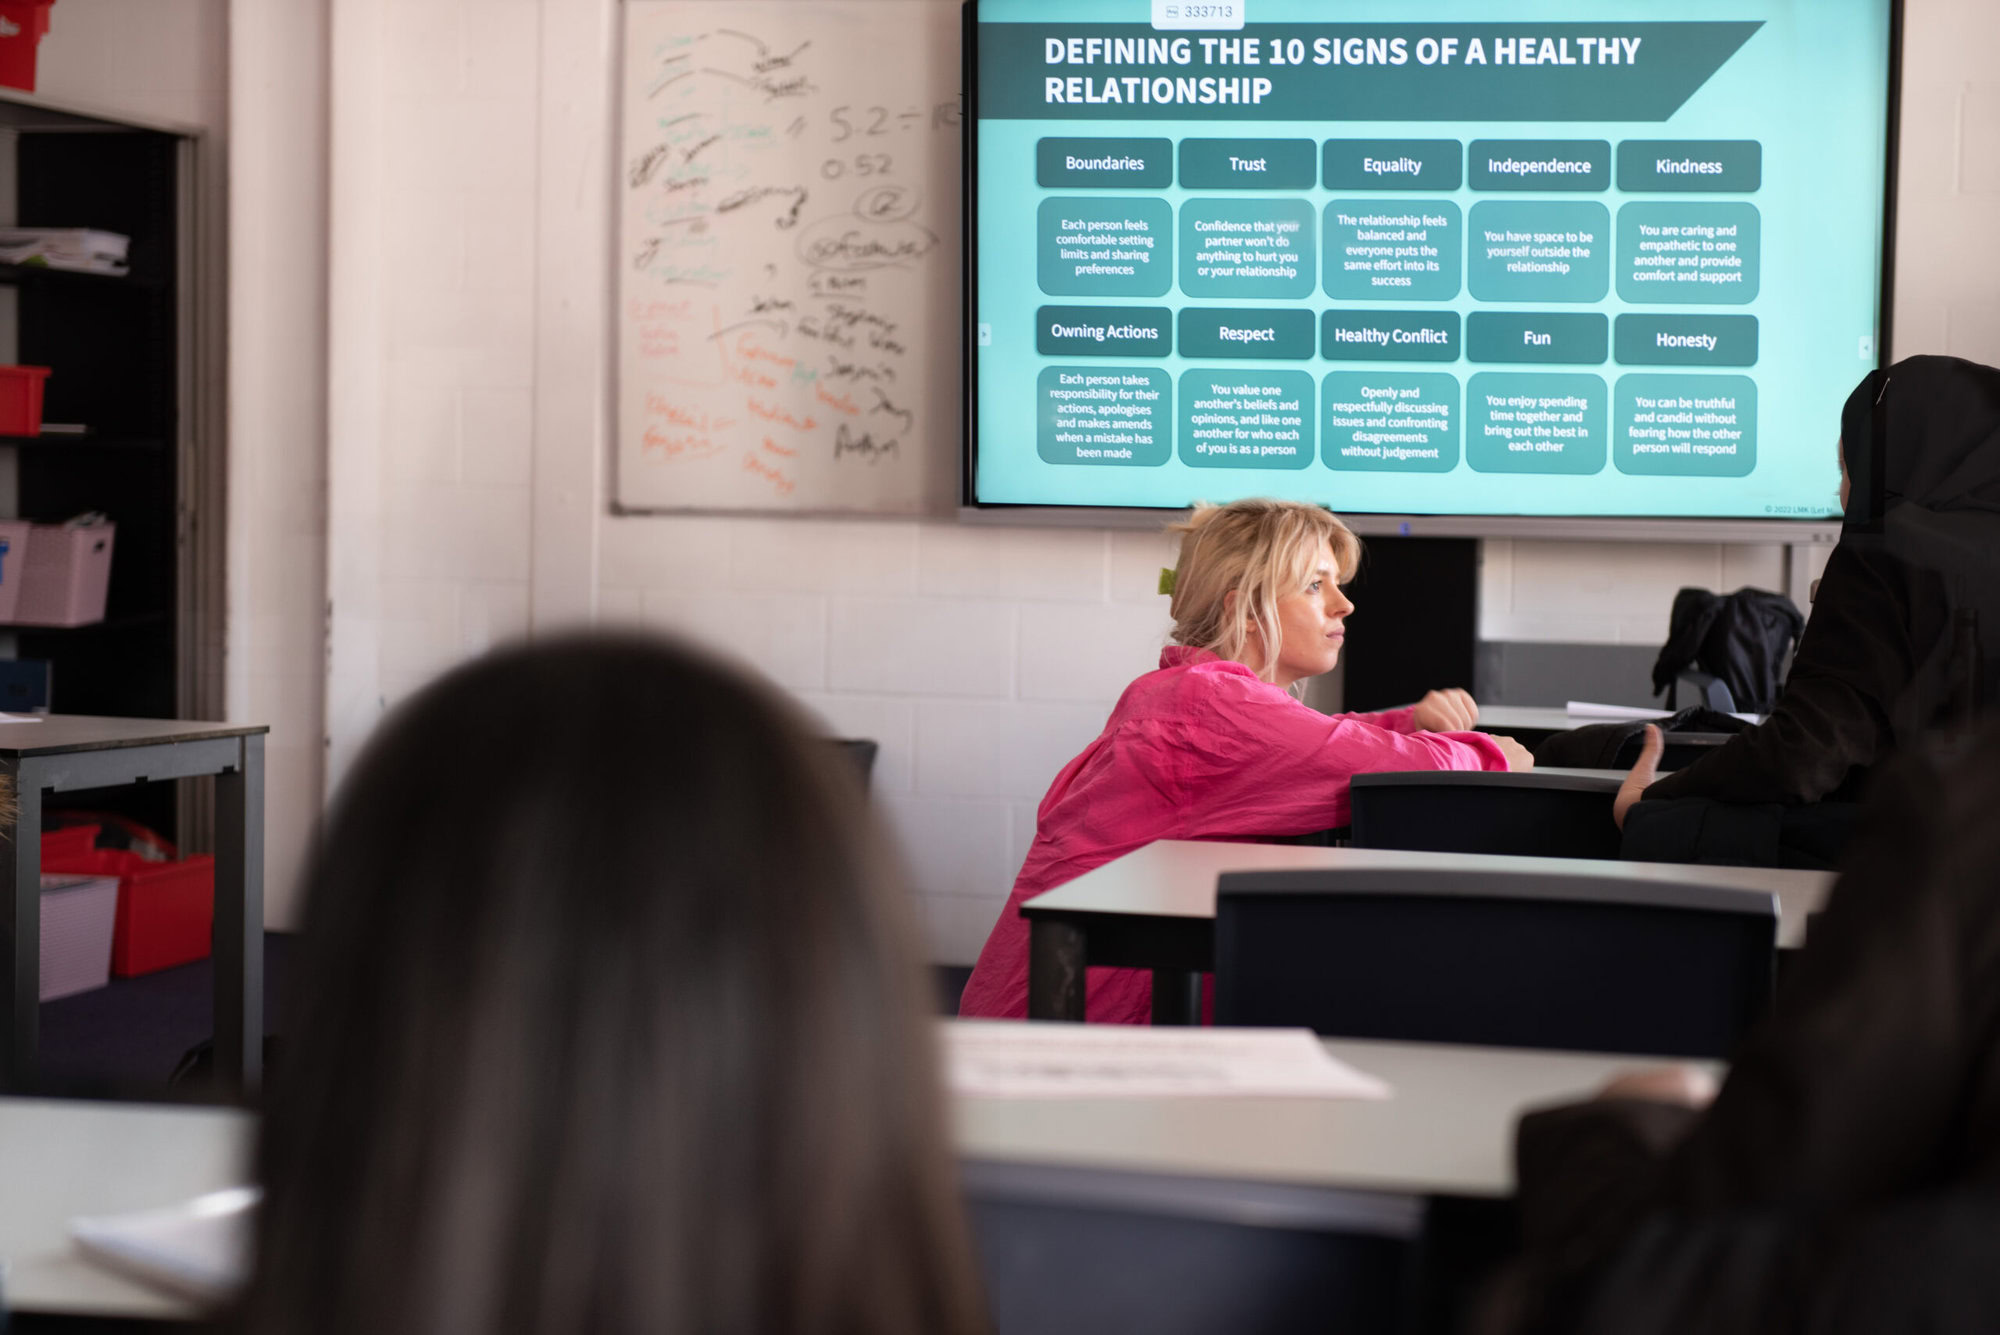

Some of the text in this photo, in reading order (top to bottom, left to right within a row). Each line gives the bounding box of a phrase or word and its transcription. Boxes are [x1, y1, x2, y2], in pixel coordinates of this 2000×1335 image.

[1184, 6, 1233, 18] 333713
[1045, 37, 1642, 65] DEFINING THE 10 SIGNS OF A HEALTHY
[1045, 76, 1272, 104] RELATIONSHIP
[1066, 155, 1145, 171] Boundaries
[1229, 156, 1267, 172] Trust
[1364, 157, 1422, 176] Equality
[1488, 157, 1592, 177] Independence
[1656, 158, 1723, 174] Kindness
[1061, 219, 1149, 232] Each person feels
[1194, 220, 1300, 235] Confidence that your
[1336, 214, 1448, 228] The relationship feels
[1357, 227, 1427, 242] balanced and
[1484, 230, 1594, 245] You have space to be
[1639, 224, 1737, 239] You are caring and
[1056, 231, 1154, 249] comfortable setting
[1204, 235, 1290, 249] partner won't do
[1639, 239, 1737, 254] empathetic to one
[1060, 248, 1150, 263] limits and sharing
[1196, 248, 1299, 265] anything to hurt you
[1345, 245, 1438, 259] everyone puts the
[1486, 243, 1591, 260] yourself outside the
[1344, 259, 1440, 272] same effort into its
[1507, 260, 1571, 275] relationship
[1633, 254, 1742, 269] another and provide
[1075, 262, 1135, 278] preferences
[1209, 264, 1297, 280] your relationship
[1633, 268, 1743, 285] comfort and support
[1371, 276, 1412, 287] success
[1051, 323, 1159, 342] Owning Actions
[1219, 326, 1275, 344] Respect
[1335, 327, 1448, 346] Healthy Conflict
[1524, 330, 1551, 346] Fun
[1656, 332, 1717, 351] Honesty
[1059, 373, 1150, 387] Each person takes
[1049, 387, 1160, 402] responsibility for their
[1211, 383, 1282, 396] You value one
[1360, 386, 1420, 401] Openly and
[1057, 403, 1152, 418] actions, apologises
[1193, 397, 1299, 411] another's beliefs and
[1332, 398, 1449, 417] respectfully discussing
[1485, 395, 1588, 411] You enjoy spending
[1635, 396, 1736, 410] You can be truthful
[1056, 417, 1153, 430] and makes amends
[1191, 412, 1302, 426] opinions, and like one
[1333, 415, 1449, 432] issues and confronting
[1490, 409, 1583, 425] time together and
[1633, 411, 1737, 425] and candid without
[1055, 431, 1153, 445] when mistake has
[1192, 425, 1300, 441] another for who each
[1352, 430, 1429, 446] disagreements
[1484, 424, 1589, 439] bring out the best in
[1628, 425, 1742, 441] fearing how the other
[1076, 446, 1133, 459] been made
[1207, 444, 1297, 457] you person
[1341, 445, 1439, 461] without judgement
[1508, 439, 1565, 453] each other
[1632, 442, 1737, 457] person will respond
